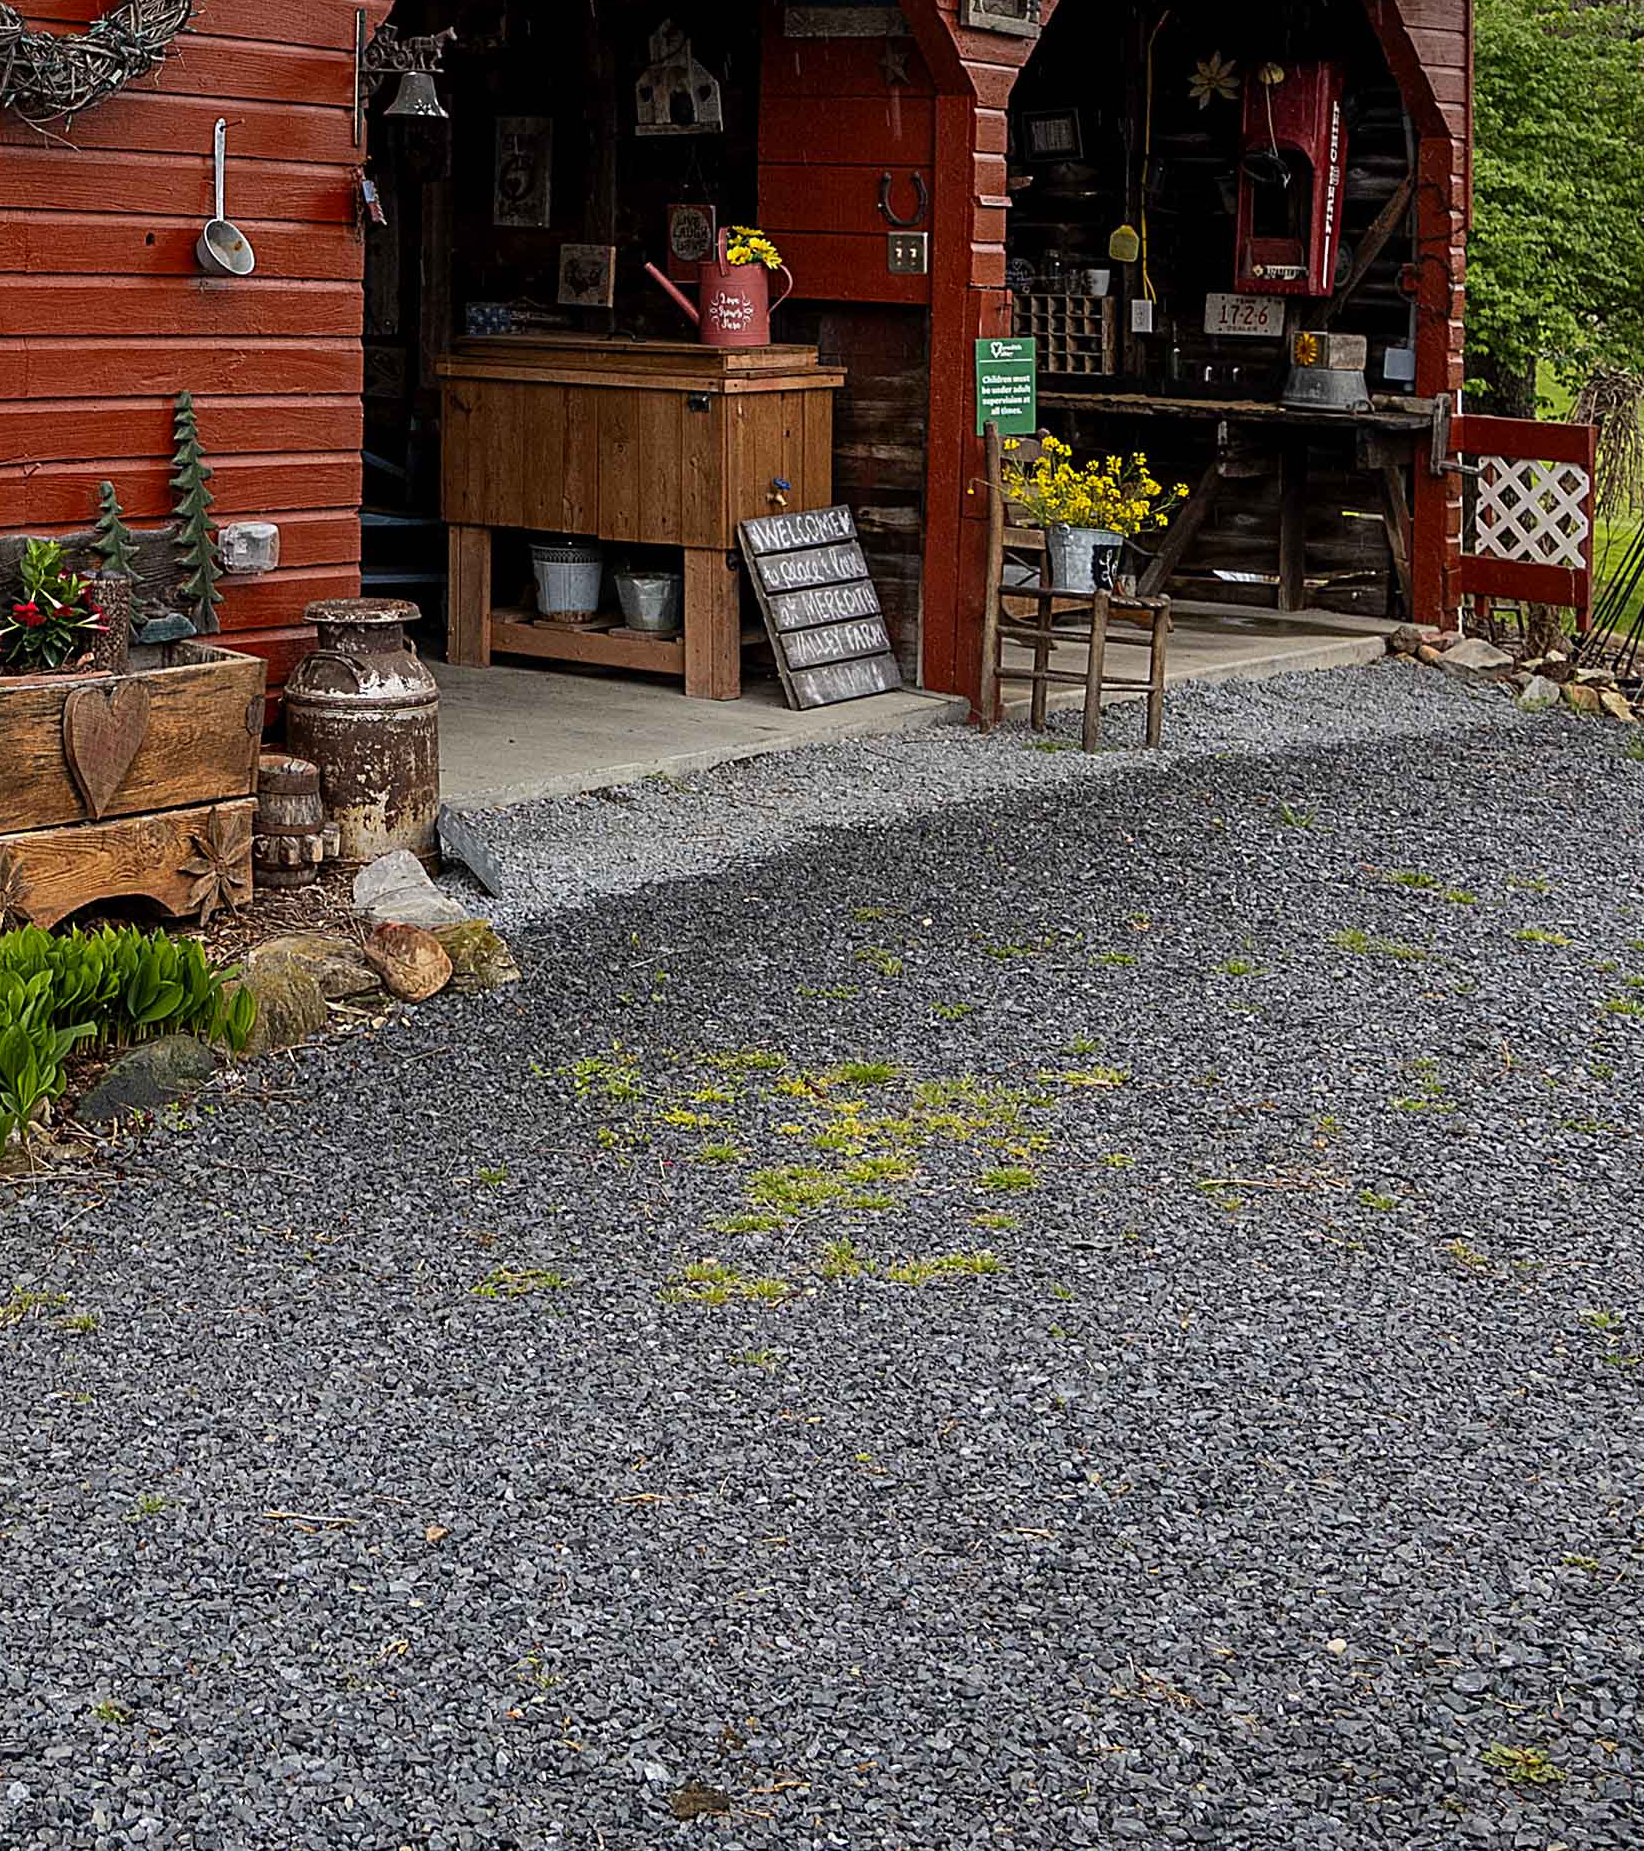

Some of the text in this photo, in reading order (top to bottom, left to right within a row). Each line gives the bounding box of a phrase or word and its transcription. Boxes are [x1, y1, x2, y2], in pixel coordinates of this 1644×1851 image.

[756, 511, 841, 551] WELCOME
[764, 569, 780, 586] to
[803, 587, 877, 624] MEREDITH
[795, 621, 891, 663] VALLEY FARM
